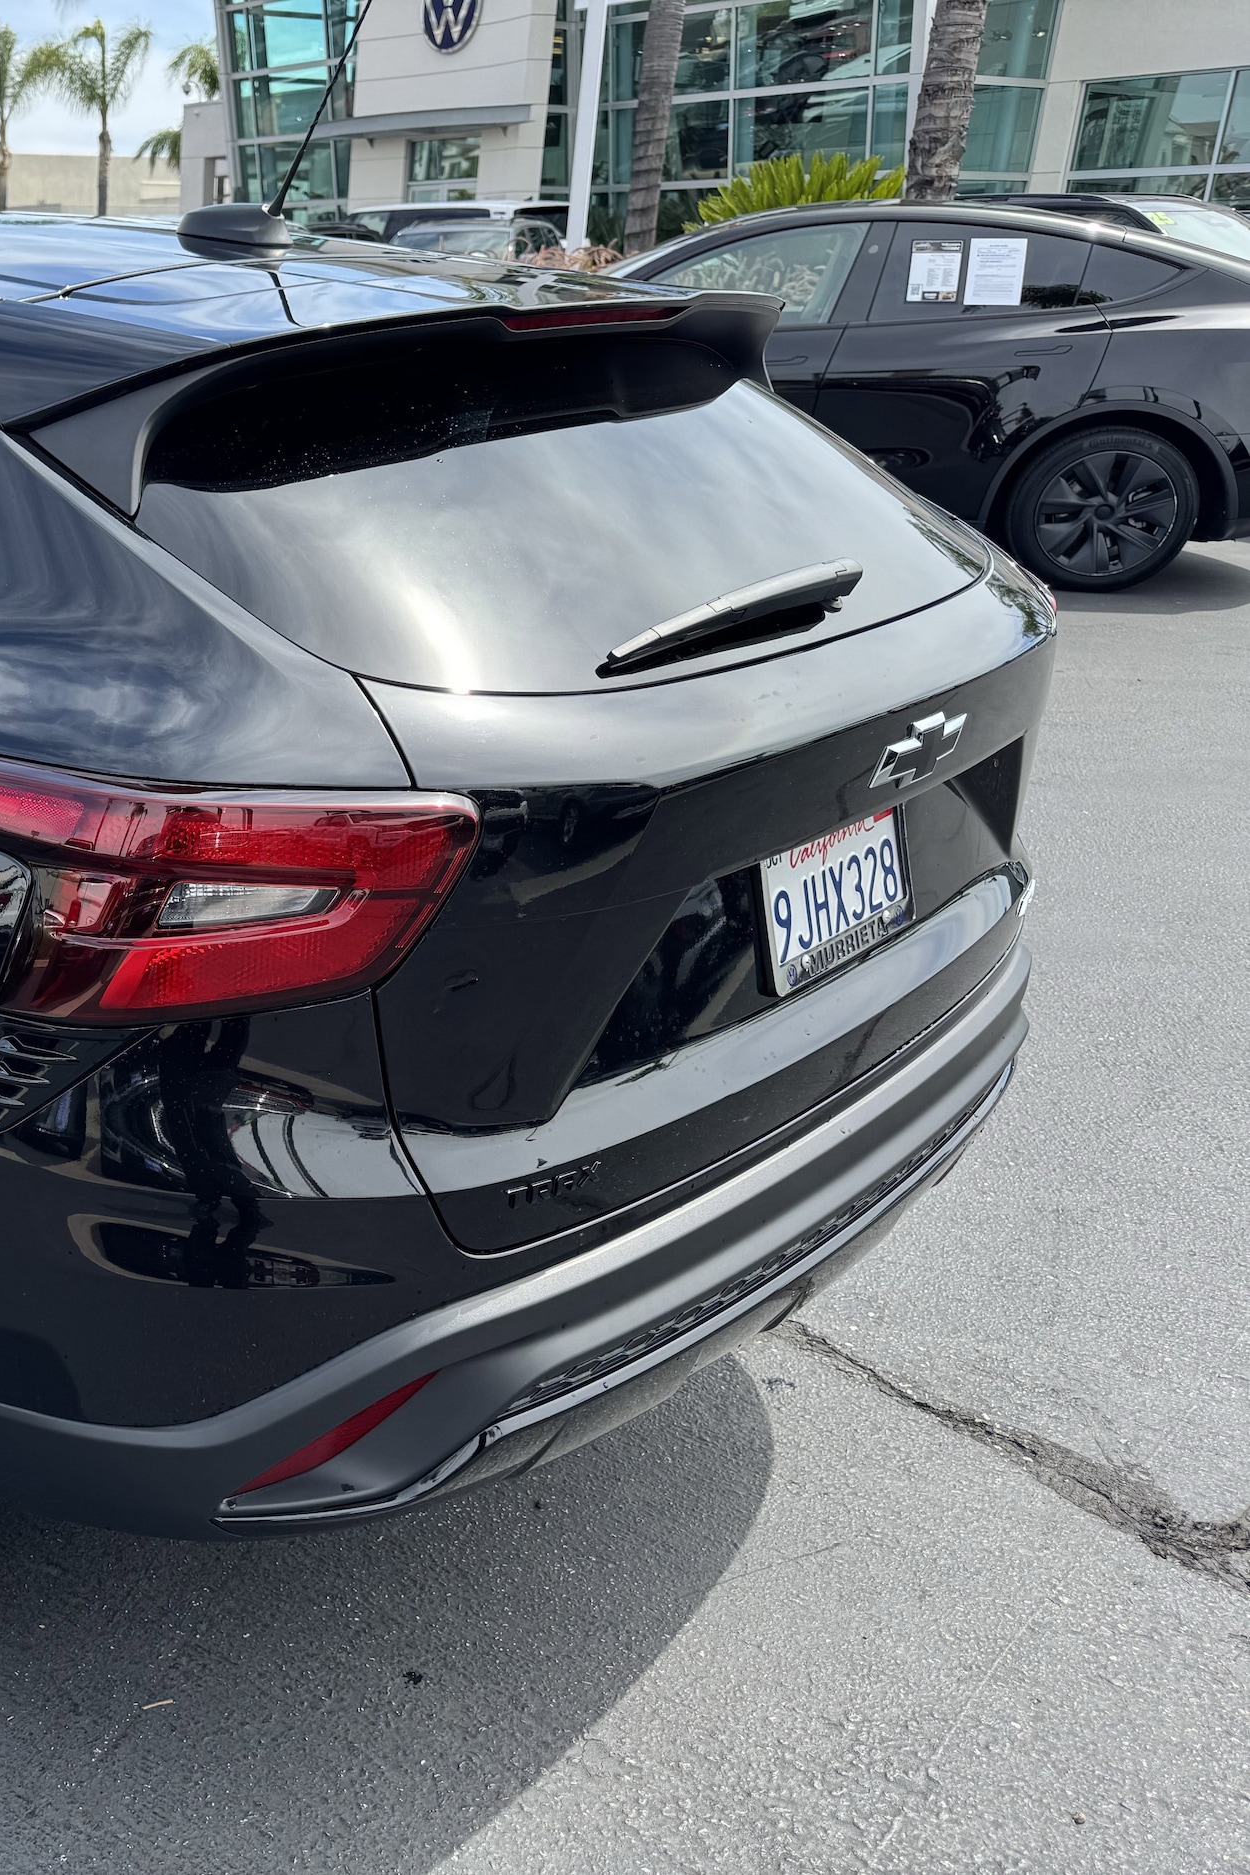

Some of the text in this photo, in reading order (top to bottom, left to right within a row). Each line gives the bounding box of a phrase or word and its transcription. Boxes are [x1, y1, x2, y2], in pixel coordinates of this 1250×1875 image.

[773, 837, 899, 964] 9JHX328
[807, 916, 890, 977] MURRIETA
[503, 1161, 602, 1209] TRAX
